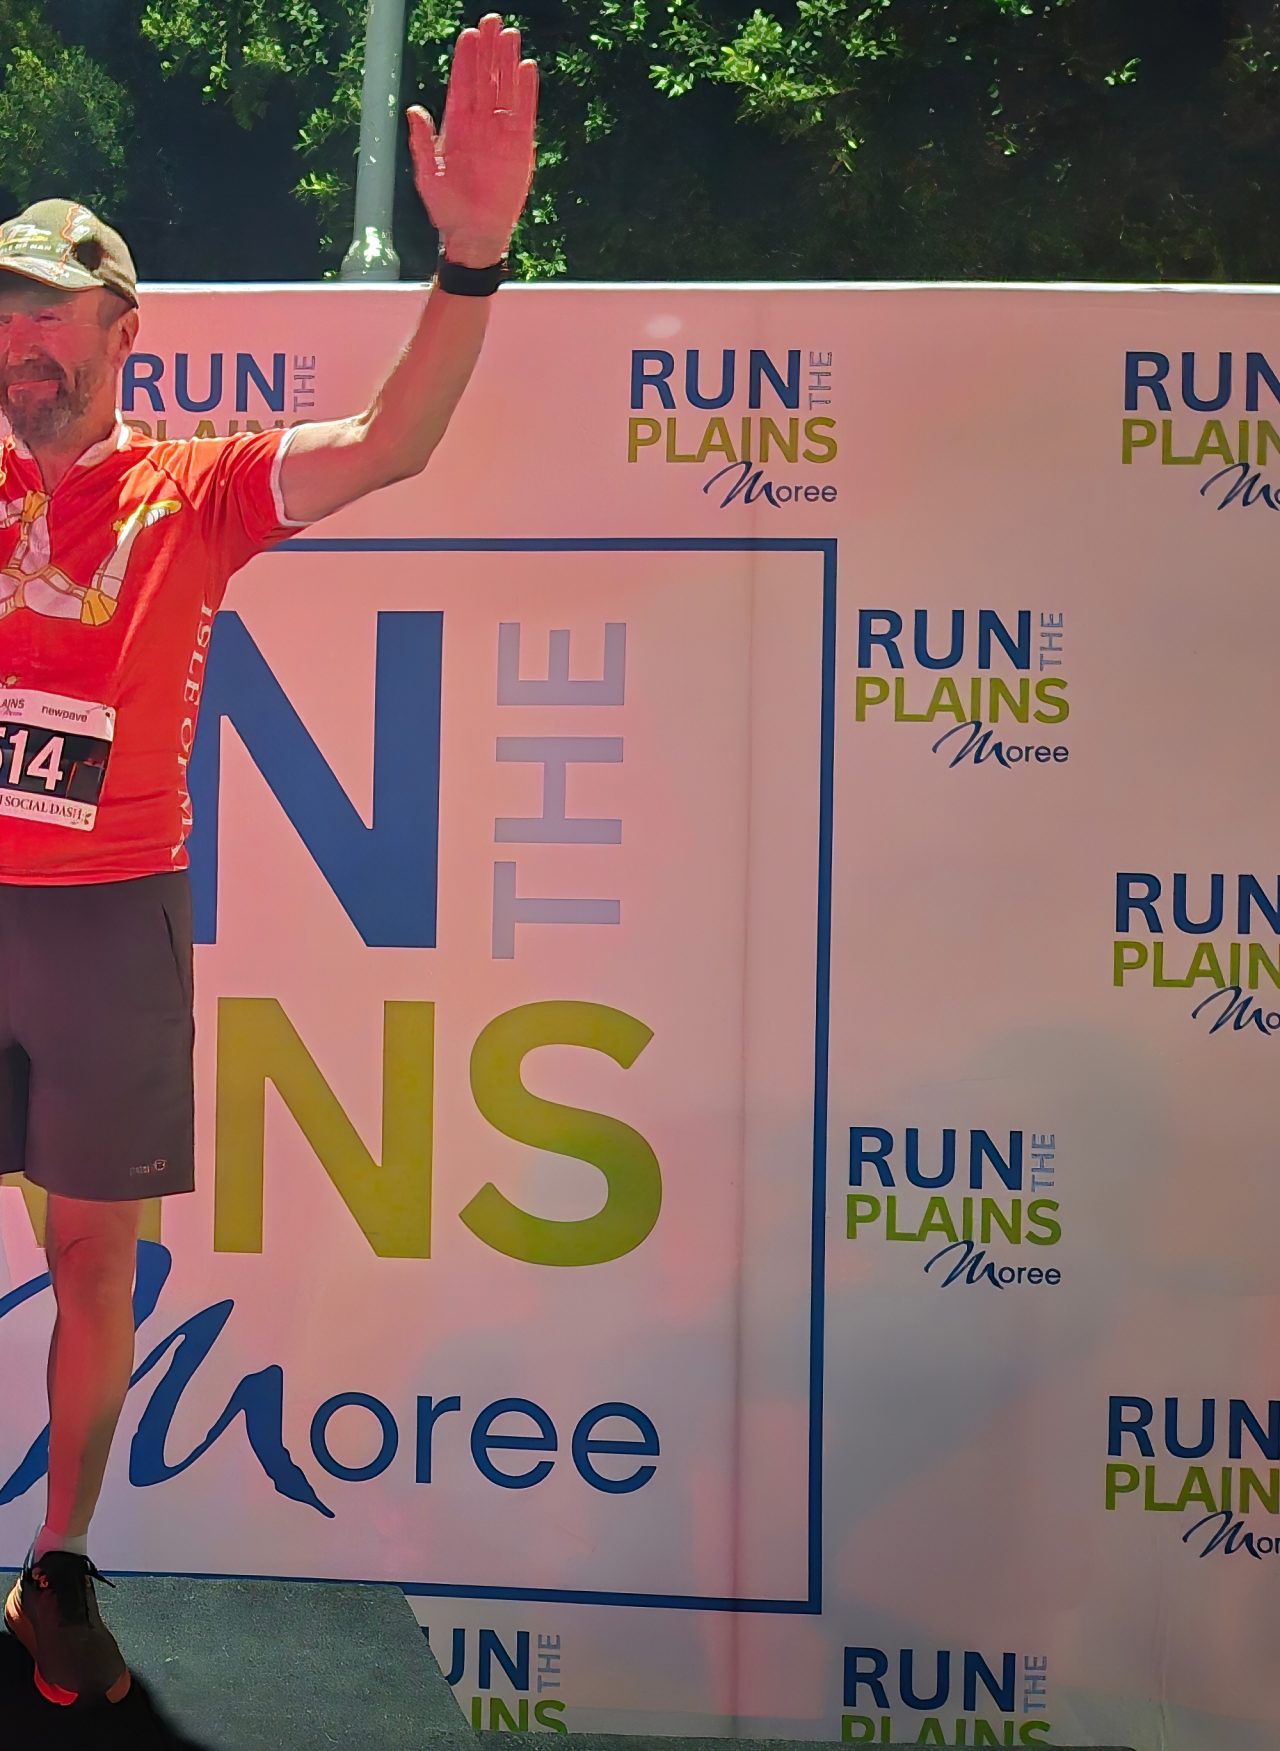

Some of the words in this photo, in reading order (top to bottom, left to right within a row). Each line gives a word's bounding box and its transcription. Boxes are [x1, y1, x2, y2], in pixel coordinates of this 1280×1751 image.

[121, 352, 286, 412] RUN
[293, 355, 315, 412] THE
[629, 349, 802, 410] RUN
[808, 350, 833, 410] THE
[627, 416, 838, 464] PLAINS
[1122, 418, 1280, 466] PLAIN
[702, 460, 838, 509] Moree
[183, 600, 213, 706] ISLE
[857, 609, 1032, 671] RUN
[1038, 611, 1064, 671] THE
[41, 706, 88, 722] newpave
[854, 676, 1070, 725] PLAINS
[931, 721, 1070, 769] Moree
[4, 795, 48, 813] SOCIAL
[492, 622, 627, 959] THE
[1116, 872, 1280, 935] RUN
[1113, 941, 1280, 989] PLAIN
[848, 1127, 1023, 1191] RUN
[1031, 1134, 1056, 1193] THE
[846, 1193, 1062, 1246] PLAINS
[924, 1239, 1061, 1290] Moree
[1108, 1395, 1280, 1460] RUN
[1105, 1463, 1280, 1514] PLAIN
[537, 1634, 561, 1693] THE
[843, 1646, 1016, 1712] RUN
[1024, 1655, 1047, 1713] THE
[472, 1696, 568, 1735] INS
